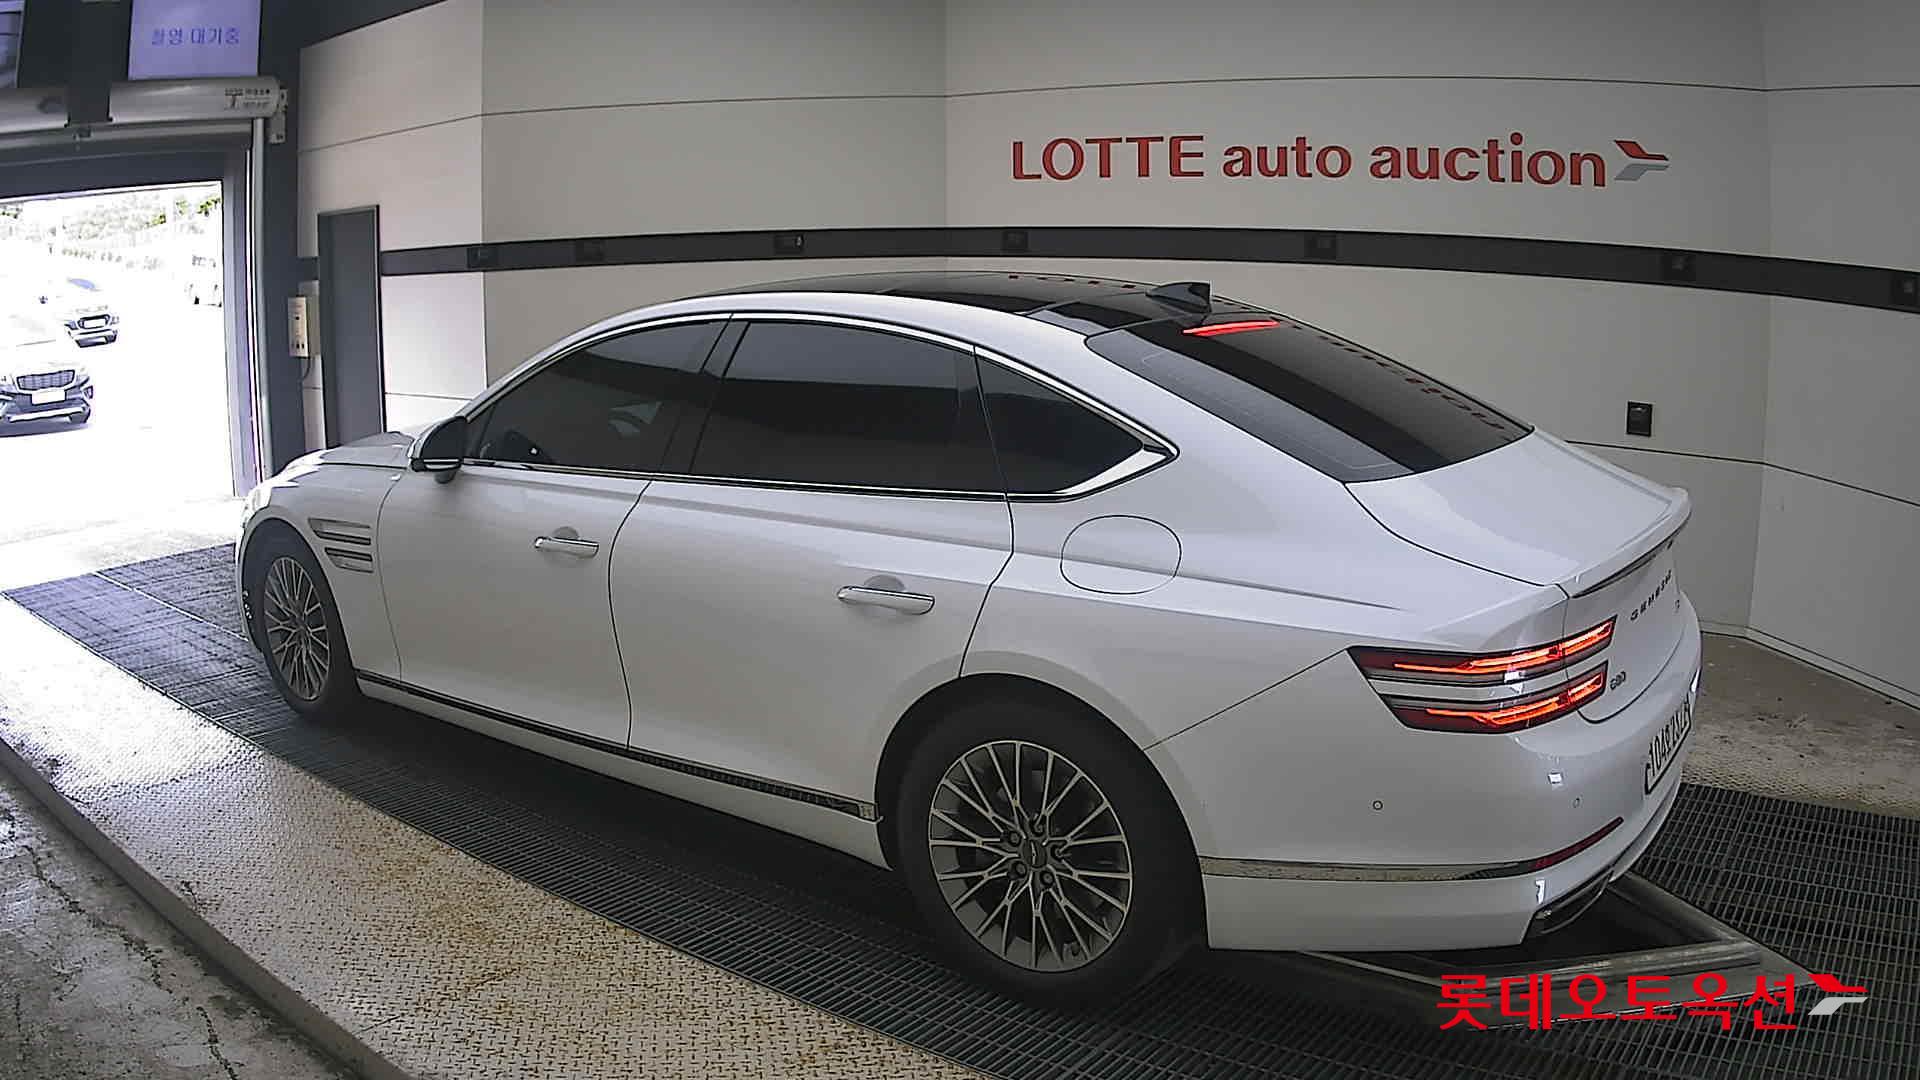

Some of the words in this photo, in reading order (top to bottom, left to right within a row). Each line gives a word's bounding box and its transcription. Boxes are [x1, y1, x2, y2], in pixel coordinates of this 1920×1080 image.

[190, 27, 240, 46] 대기중
[1012, 135, 1204, 180] LOTTE
[1222, 136, 1352, 178] auto
[1369, 132, 1607, 187] auction
